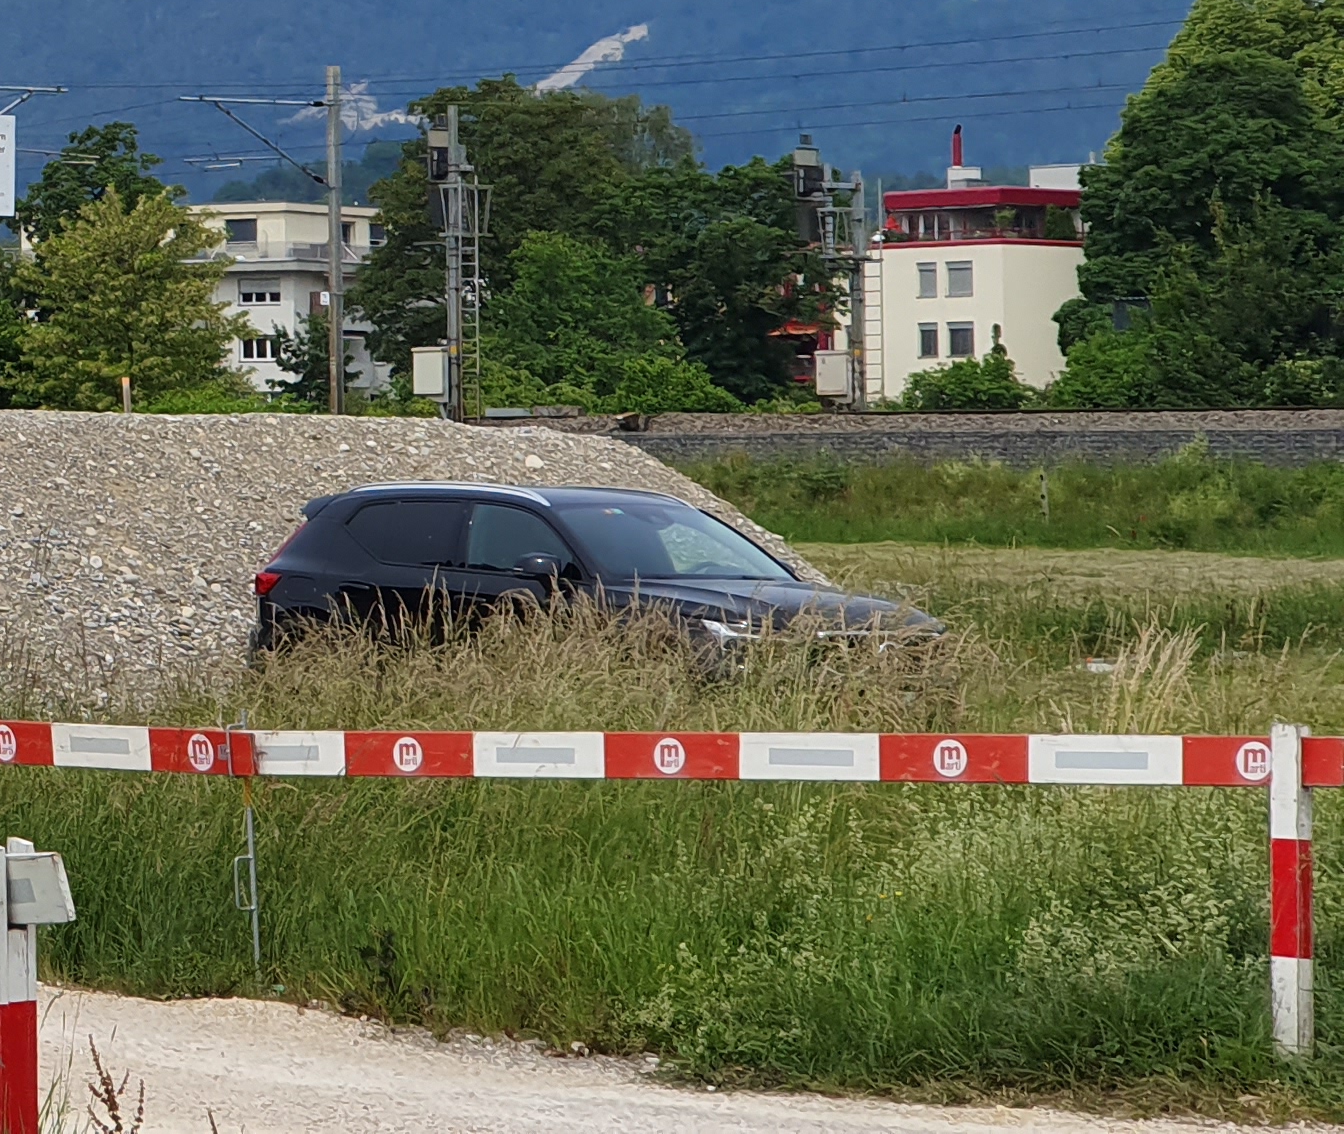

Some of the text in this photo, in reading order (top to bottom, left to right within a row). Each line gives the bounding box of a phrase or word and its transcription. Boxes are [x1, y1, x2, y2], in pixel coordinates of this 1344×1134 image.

[660, 743, 679, 768] marti
[940, 746, 961, 771] marti
[1244, 748, 1266, 774] marti
